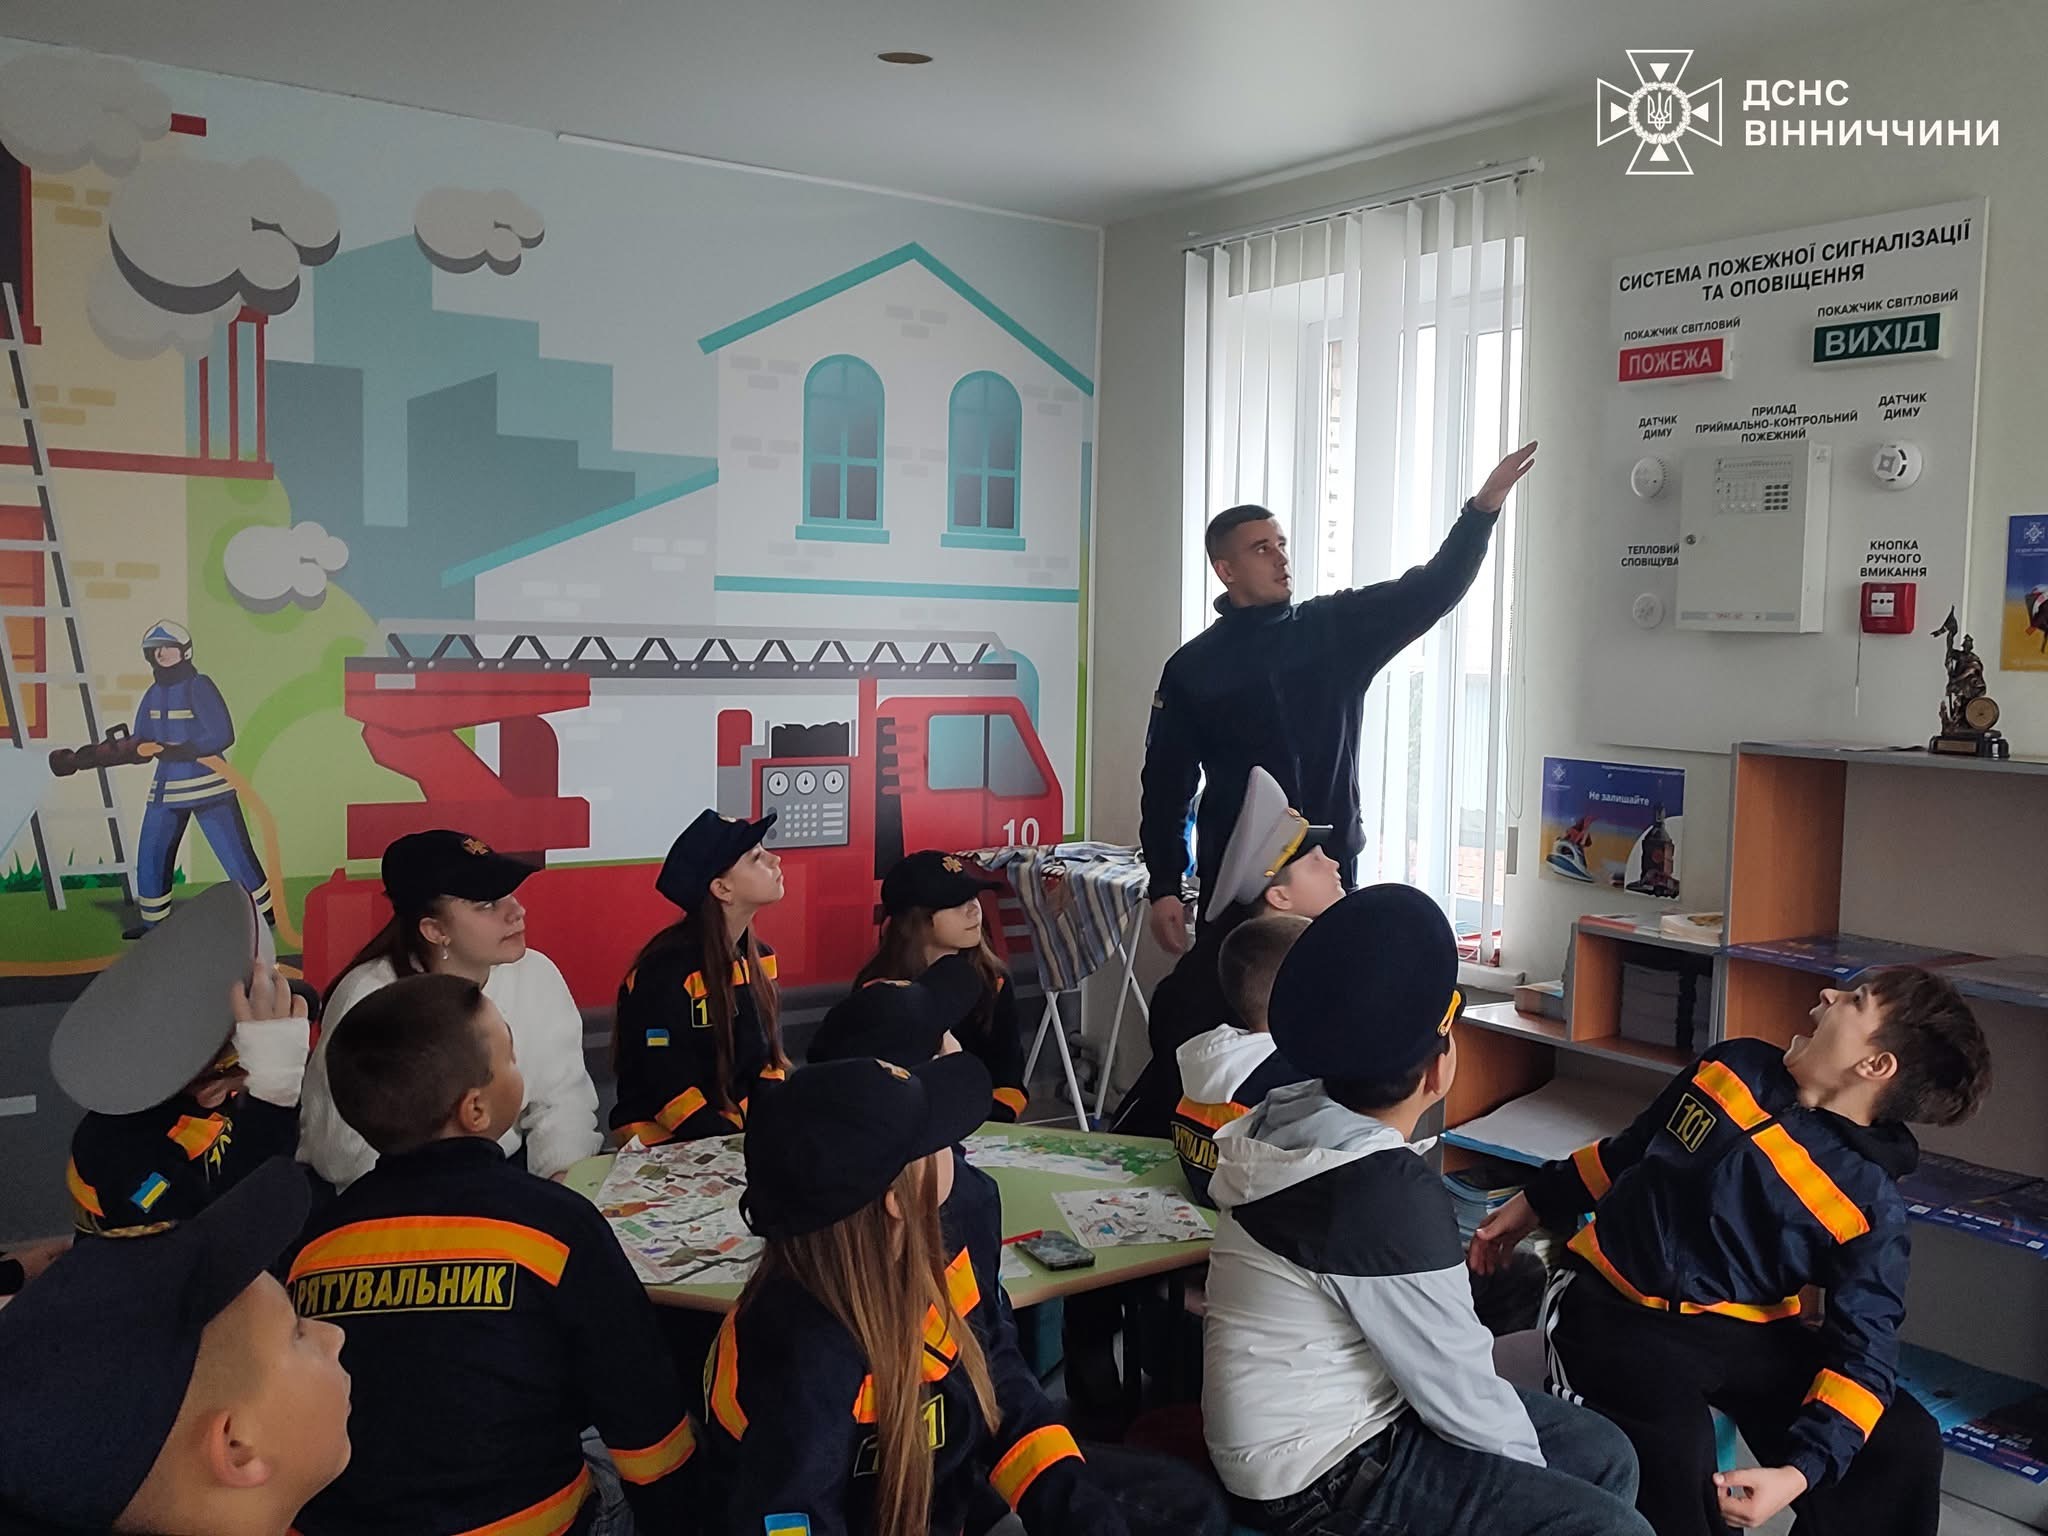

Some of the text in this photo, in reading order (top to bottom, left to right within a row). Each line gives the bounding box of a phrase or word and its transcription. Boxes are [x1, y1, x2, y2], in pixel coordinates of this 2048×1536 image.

[1619, 218, 1971, 292] СИСТЕМА ПОЖЕЖНОЇ СИГНАЛІЗАЦІЇ
[1702, 264, 1864, 301] ТА ОПОВІЩЕННЯ
[1817, 289, 1959, 317] ПОКАЖЧИК СВІТЛОВИЙ
[1624, 315, 1741, 341] ПОКАЖЧИК СВІТЛОВИЙ
[1824, 320, 1927, 357] ВИХІД
[1629, 346, 1713, 376] ПОЖЕЖА
[1878, 392, 1927, 408] ДАТЧИК
[1752, 403, 1797, 417] ПРИЛАД
[1883, 406, 1921, 421] ДИМУ
[1638, 414, 1678, 429] ДАТЧИК
[1695, 410, 1858, 434] ПРИЙМАЛЬНО-КОНТРОЛЬНИЙ
[1642, 427, 1672, 441] ДИМУ
[1741, 427, 1806, 443] ПОЖЕЖНИЙ
[1627, 542, 1680, 555] ТЕПЛОВИЙ
[1870, 540, 1919, 550] КНОПКА
[1621, 557, 1679, 568] СПОВІЩУВА
[1866, 554, 1922, 564] РУЧНОГО
[1860, 567, 1927, 577] ВМИКАННЯ
[1588, 791, 1650, 806] Не залишайте
[1002, 817, 1040, 847] 10
[1676, 1103, 1712, 1149] 101
[296, 1265, 507, 1318] РЯТУВАЛЬНИК
